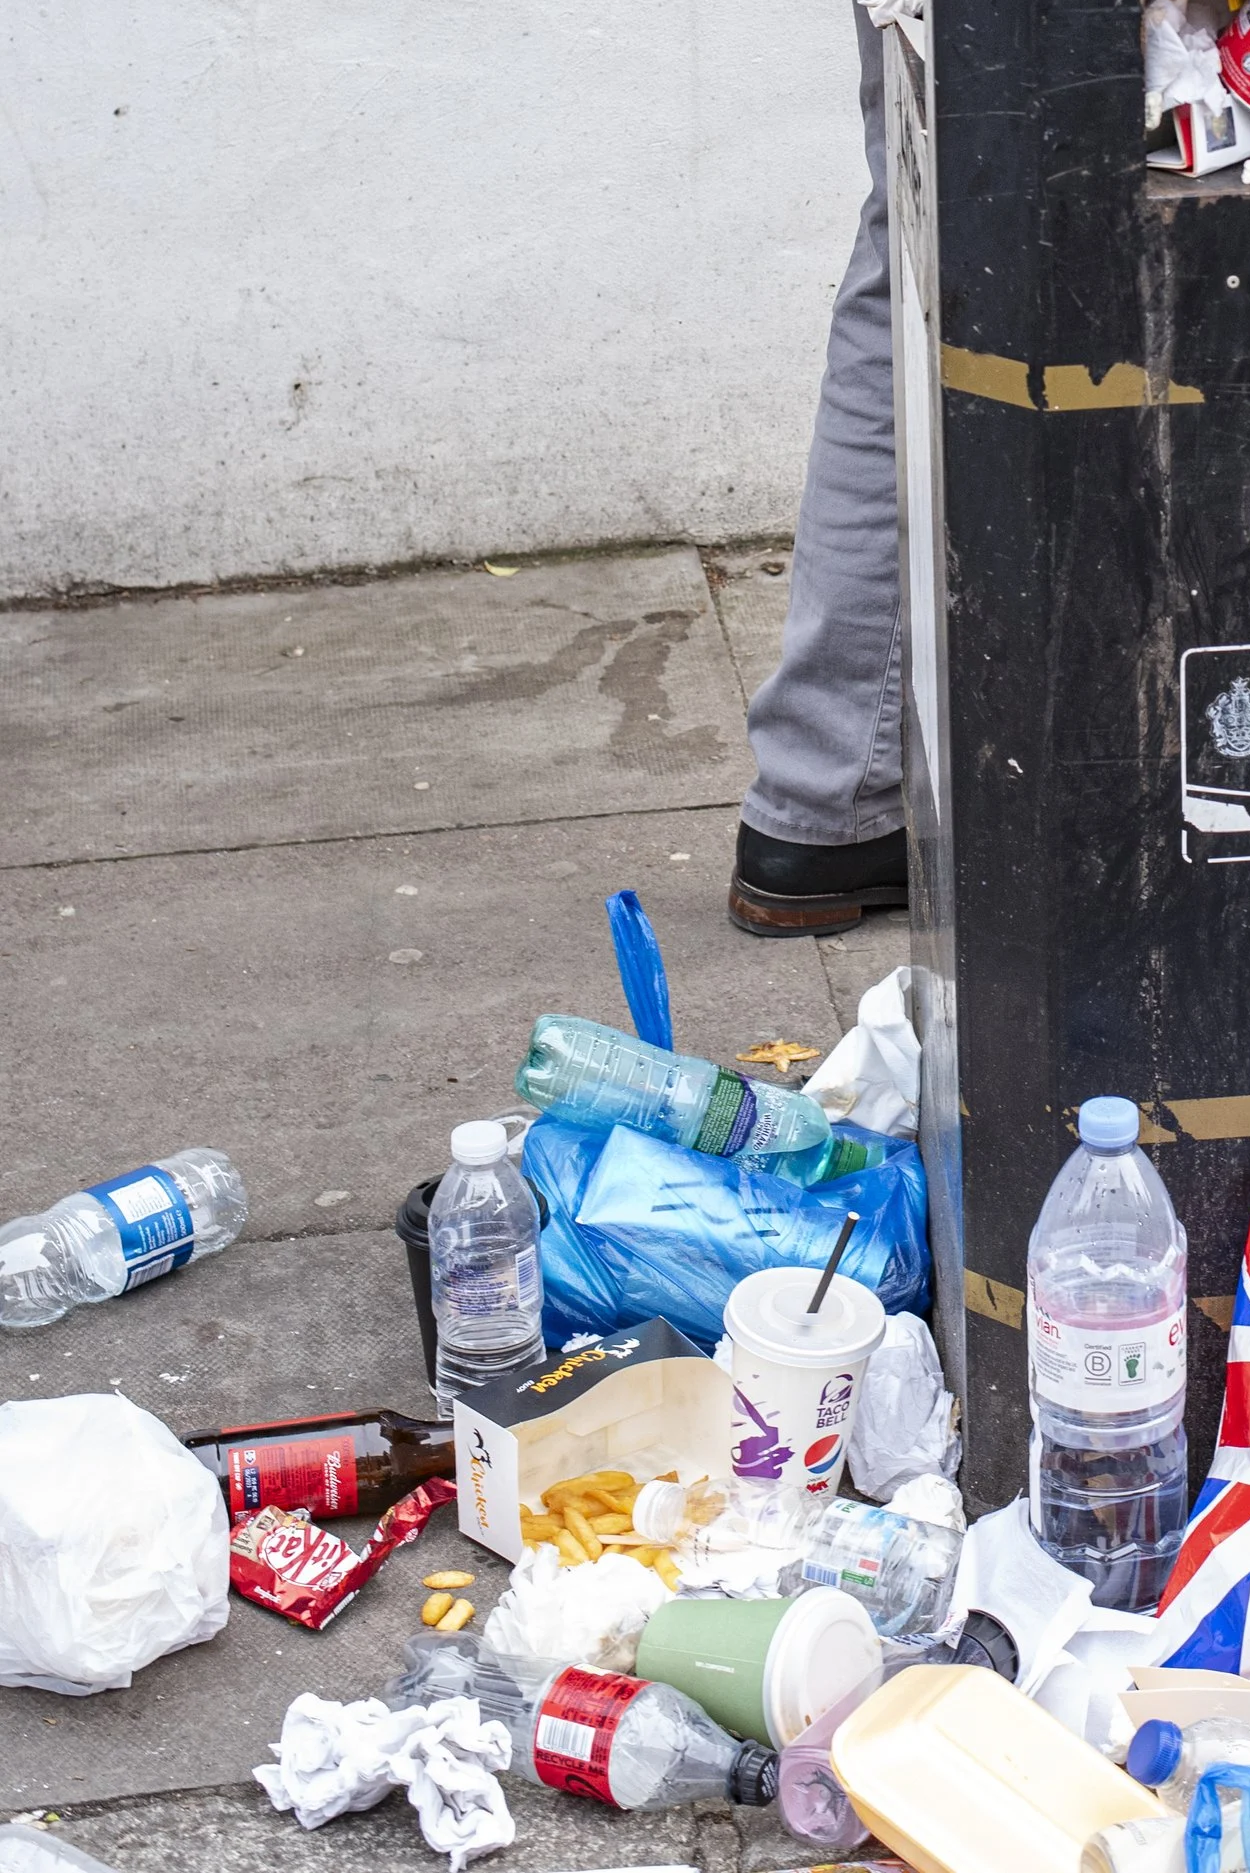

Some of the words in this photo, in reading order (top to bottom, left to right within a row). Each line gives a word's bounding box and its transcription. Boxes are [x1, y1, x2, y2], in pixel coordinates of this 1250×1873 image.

[1084, 1343, 1112, 1351] Certified
[530, 1349, 607, 1394] Chicken
[1091, 1355, 1105, 1372] B
[816, 1401, 850, 1418] TACO
[816, 1412, 847, 1429] BELL
[326, 1450, 342, 1510] Budweiser
[470, 1457, 490, 1529] Chicken
[265, 1526, 352, 1587] KitKat
[536, 1750, 585, 1772] RECYCLE
[588, 1762, 607, 1777] ME
